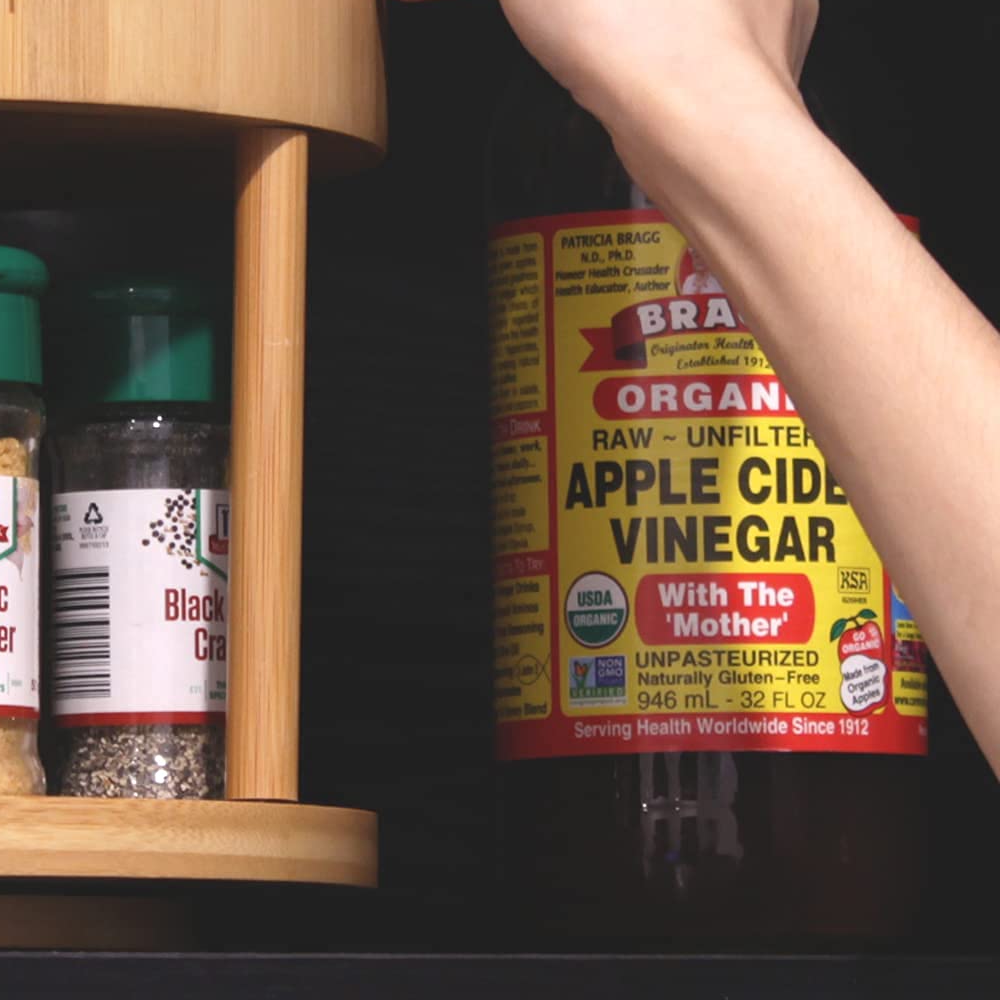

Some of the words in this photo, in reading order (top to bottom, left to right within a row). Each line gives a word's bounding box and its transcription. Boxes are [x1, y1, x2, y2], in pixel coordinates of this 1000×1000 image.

[561, 234, 612, 249] PATRICIA
[617, 232, 660, 245] BRAGG
[588, 266, 620, 277] Health
[623, 264, 669, 276] Crusader
[585, 283, 631, 294] Educator,
[634, 281, 670, 291] Author
[637, 298, 750, 335] BRA
[651, 340, 709, 356] Originator
[714, 338, 754, 350] Health
[677, 356, 740, 370] Established
[744, 356, 770, 368] 191
[593, 428, 654, 450] RAW
[565, 458, 721, 510] APPLE
[738, 457, 848, 505] CIDE
[610, 515, 836, 565] VINEGAR
[577, 590, 613, 606] USDA
[658, 582, 728, 607] With
[737, 581, 794, 606] The
[164, 588, 225, 622] Black
[573, 612, 618, 627] ORGANIC
[666, 612, 789, 637] 'Mother'
[853, 632, 865, 641] GO
[842, 639, 881, 654] ORGANIC
[597, 658, 622, 668] NON
[635, 650, 818, 668] UNPASTEURIZED
[597, 667, 623, 678] GMO
[637, 671, 712, 687] Naturally
[844, 668, 863, 682] Made
[864, 663, 879, 674] from
[847, 675, 881, 693] Organic
[637, 691, 677, 710] 946
[684, 691, 719, 709] mL
[740, 692, 765, 709] 32
[773, 692, 791, 708] FL
[801, 692, 826, 709] OZ
[852, 689, 881, 705] Apples
[574, 721, 632, 740] Serving
[637, 719, 691, 736] Health
[696, 717, 788, 736] Worldwide
[792, 718, 835, 735] Since
[839, 719, 869, 735] 1912
